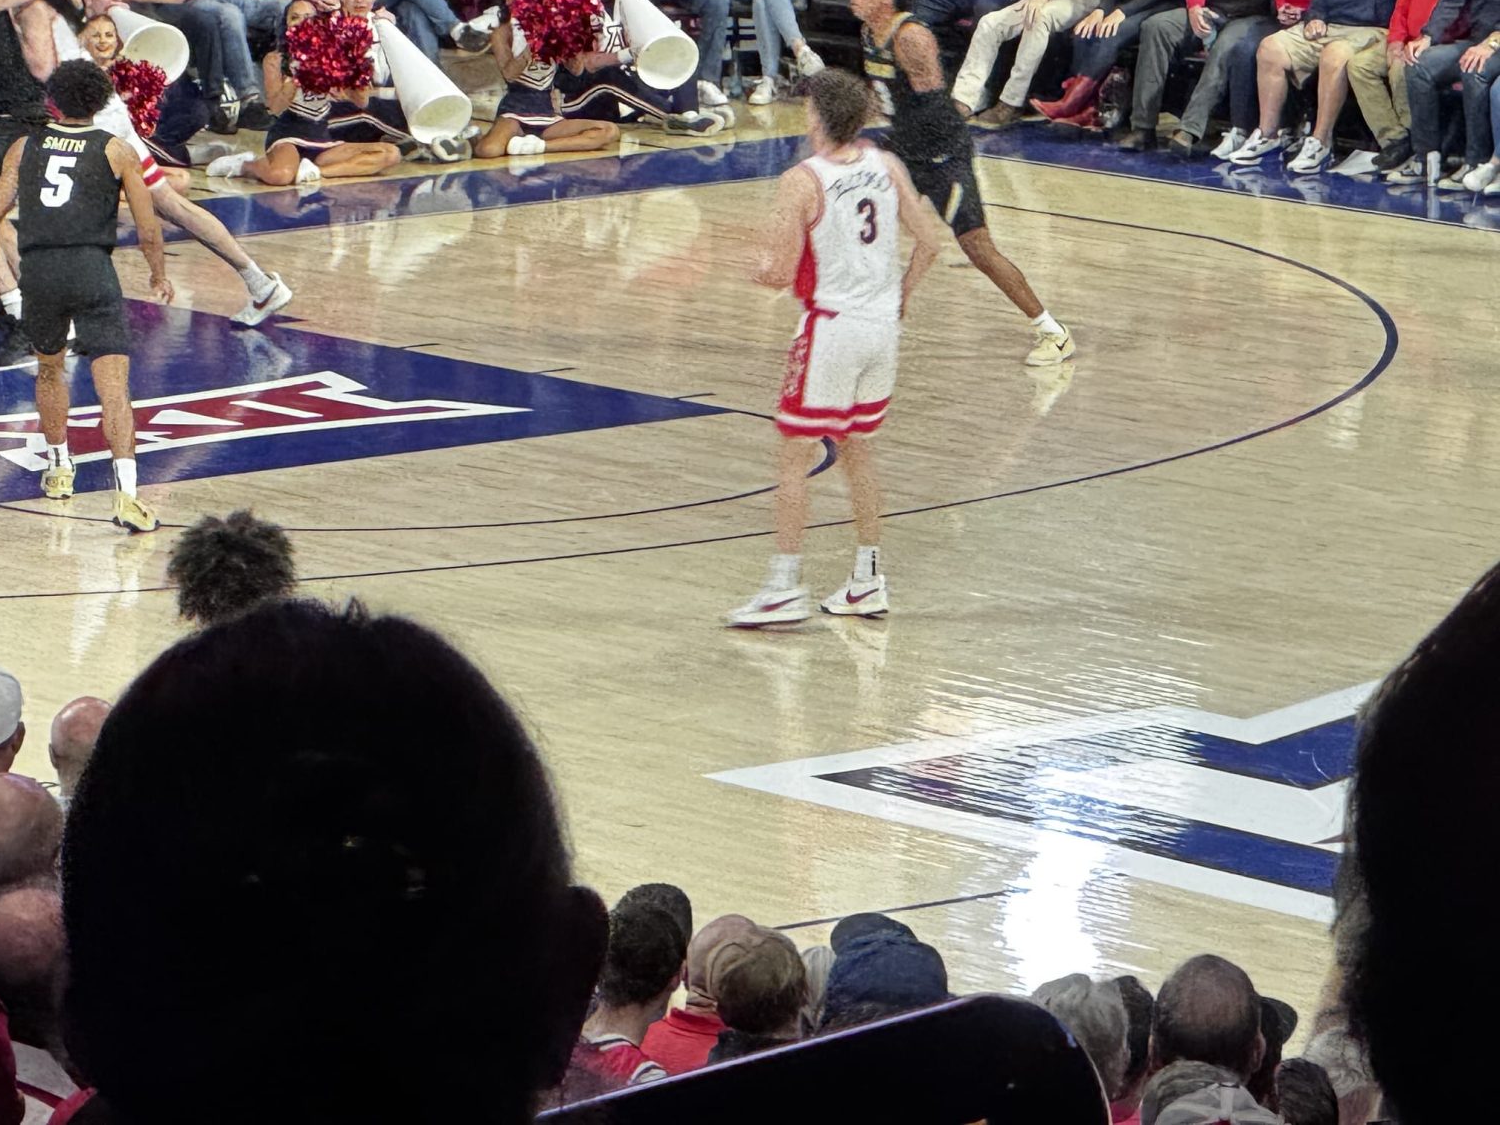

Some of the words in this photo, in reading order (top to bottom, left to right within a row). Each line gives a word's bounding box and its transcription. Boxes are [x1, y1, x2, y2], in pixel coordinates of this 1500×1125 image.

[41, 135, 87, 154] SMITH
[39, 164, 78, 208] 5
[857, 197, 877, 245] 3
